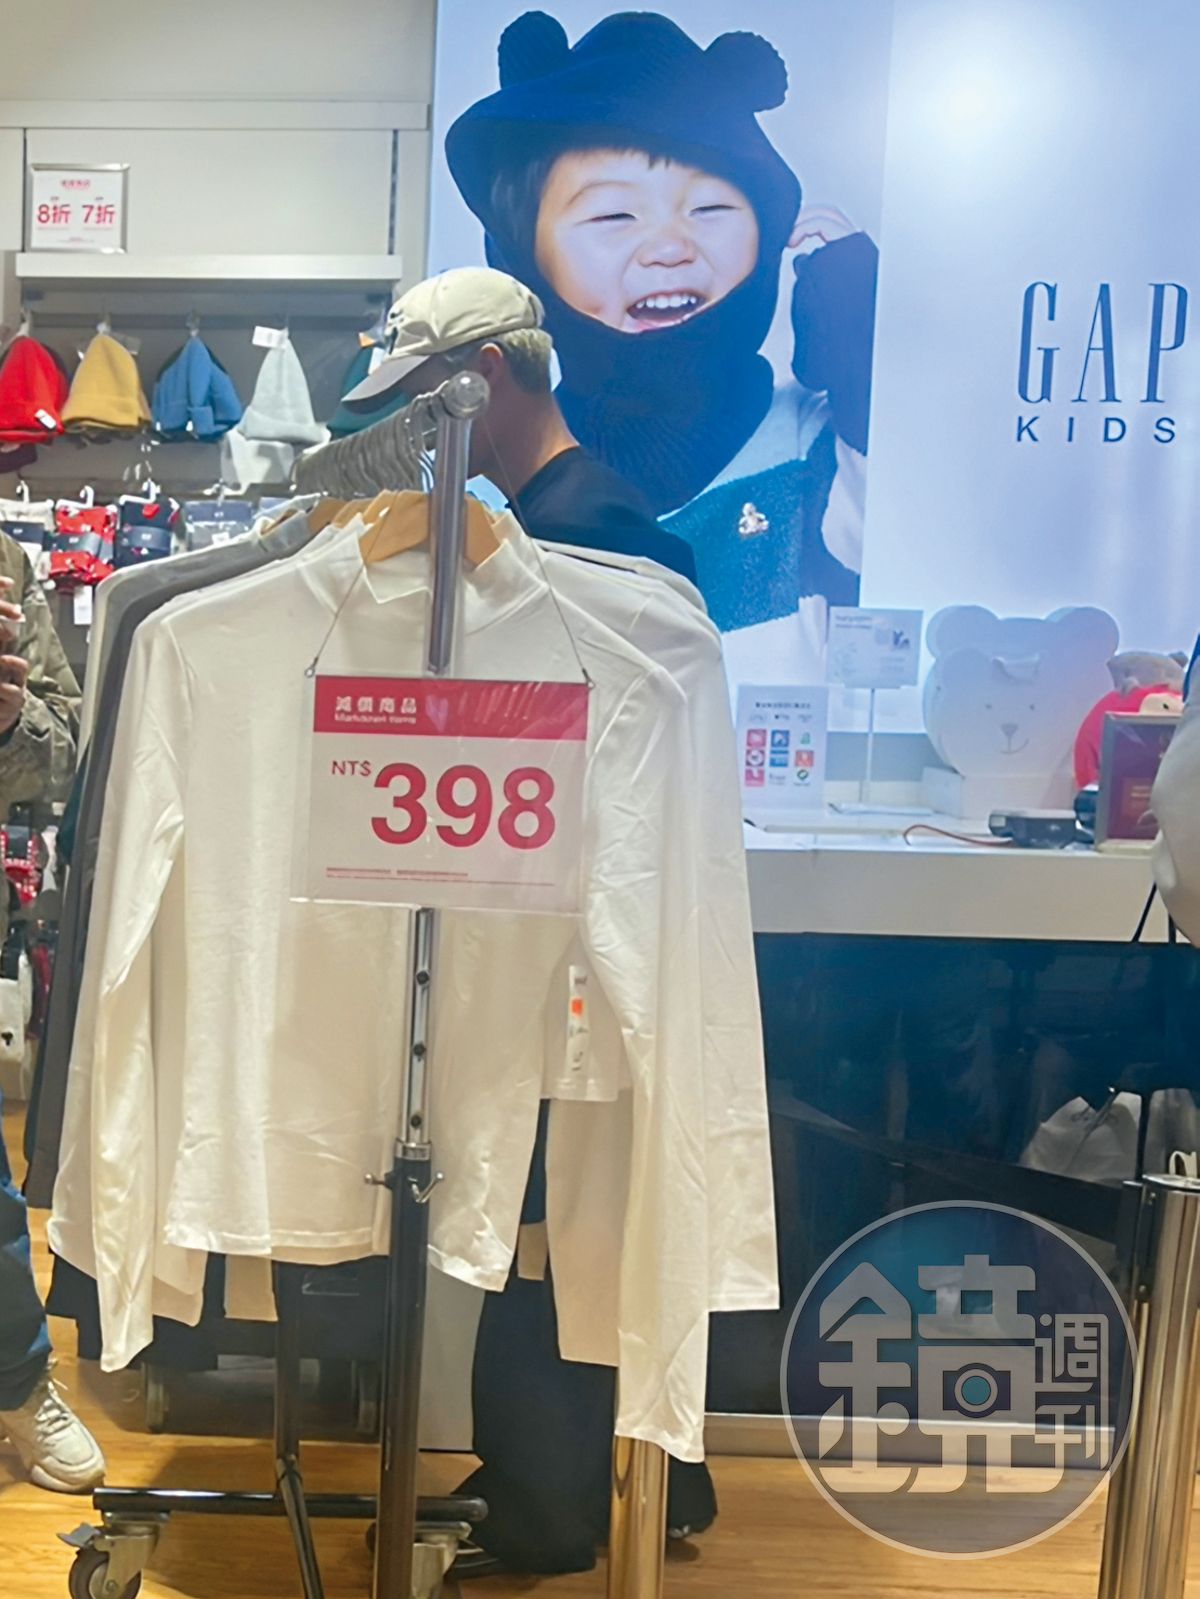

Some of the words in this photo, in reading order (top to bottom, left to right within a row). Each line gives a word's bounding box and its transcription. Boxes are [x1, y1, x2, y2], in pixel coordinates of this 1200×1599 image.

[37, 204, 71, 224] 8折
[81, 204, 115, 224] 7折
[1017, 281, 1188, 404] GAP
[1016, 415, 1176, 443] KIDS
[371, 762, 556, 850] 398
